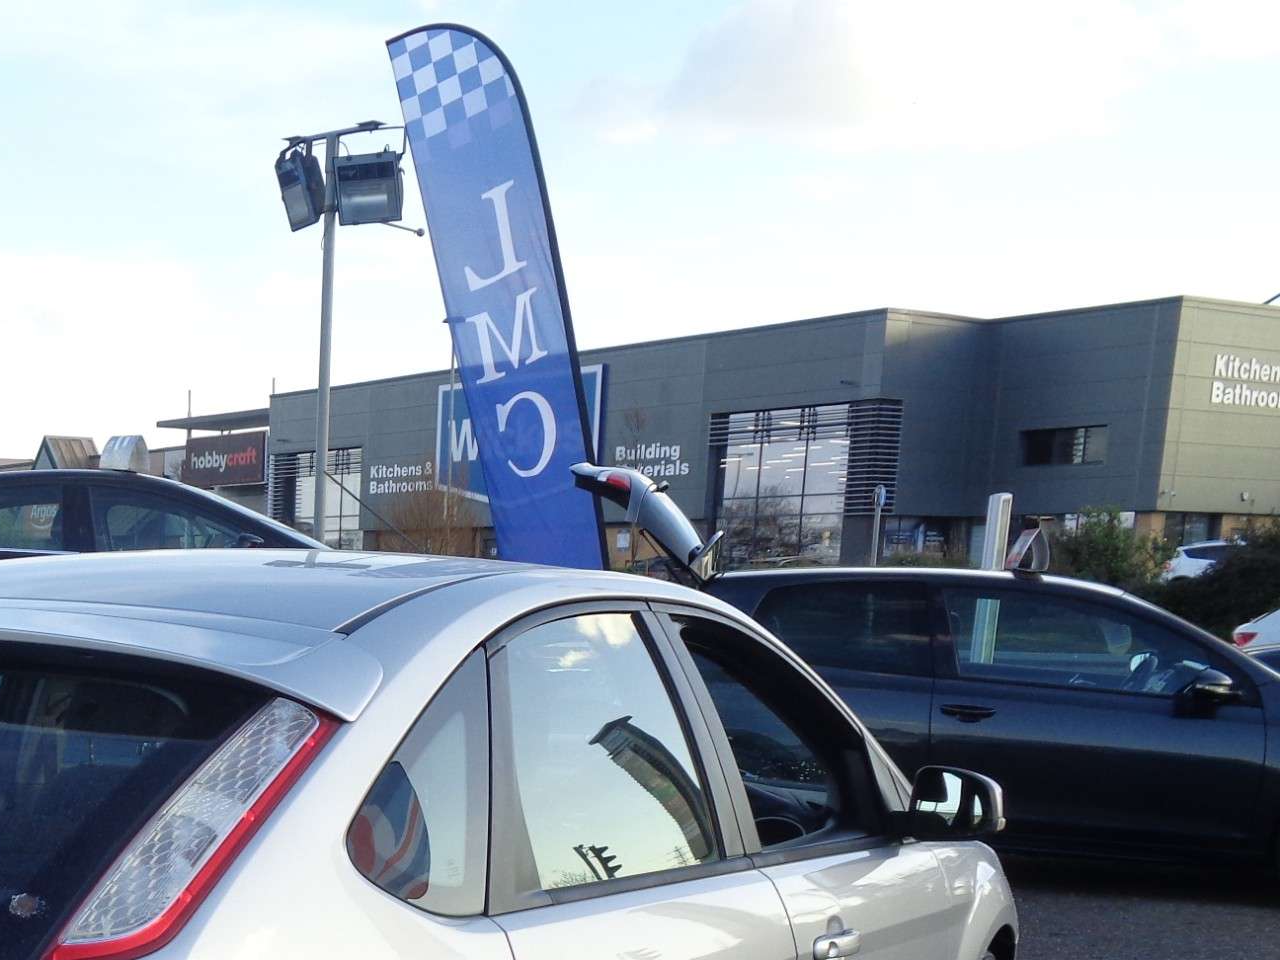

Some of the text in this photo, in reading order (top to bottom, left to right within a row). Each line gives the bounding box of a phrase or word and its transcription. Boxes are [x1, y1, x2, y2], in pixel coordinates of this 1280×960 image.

[1210, 381, 1280, 408] Bathroo
[191, 446, 257, 473] hobbycraft
[615, 442, 681, 461] Building
[370, 461, 432, 478] Kitchens &
[369, 480, 433, 495] Bathrooms
[31, 504, 57, 522] Argos
